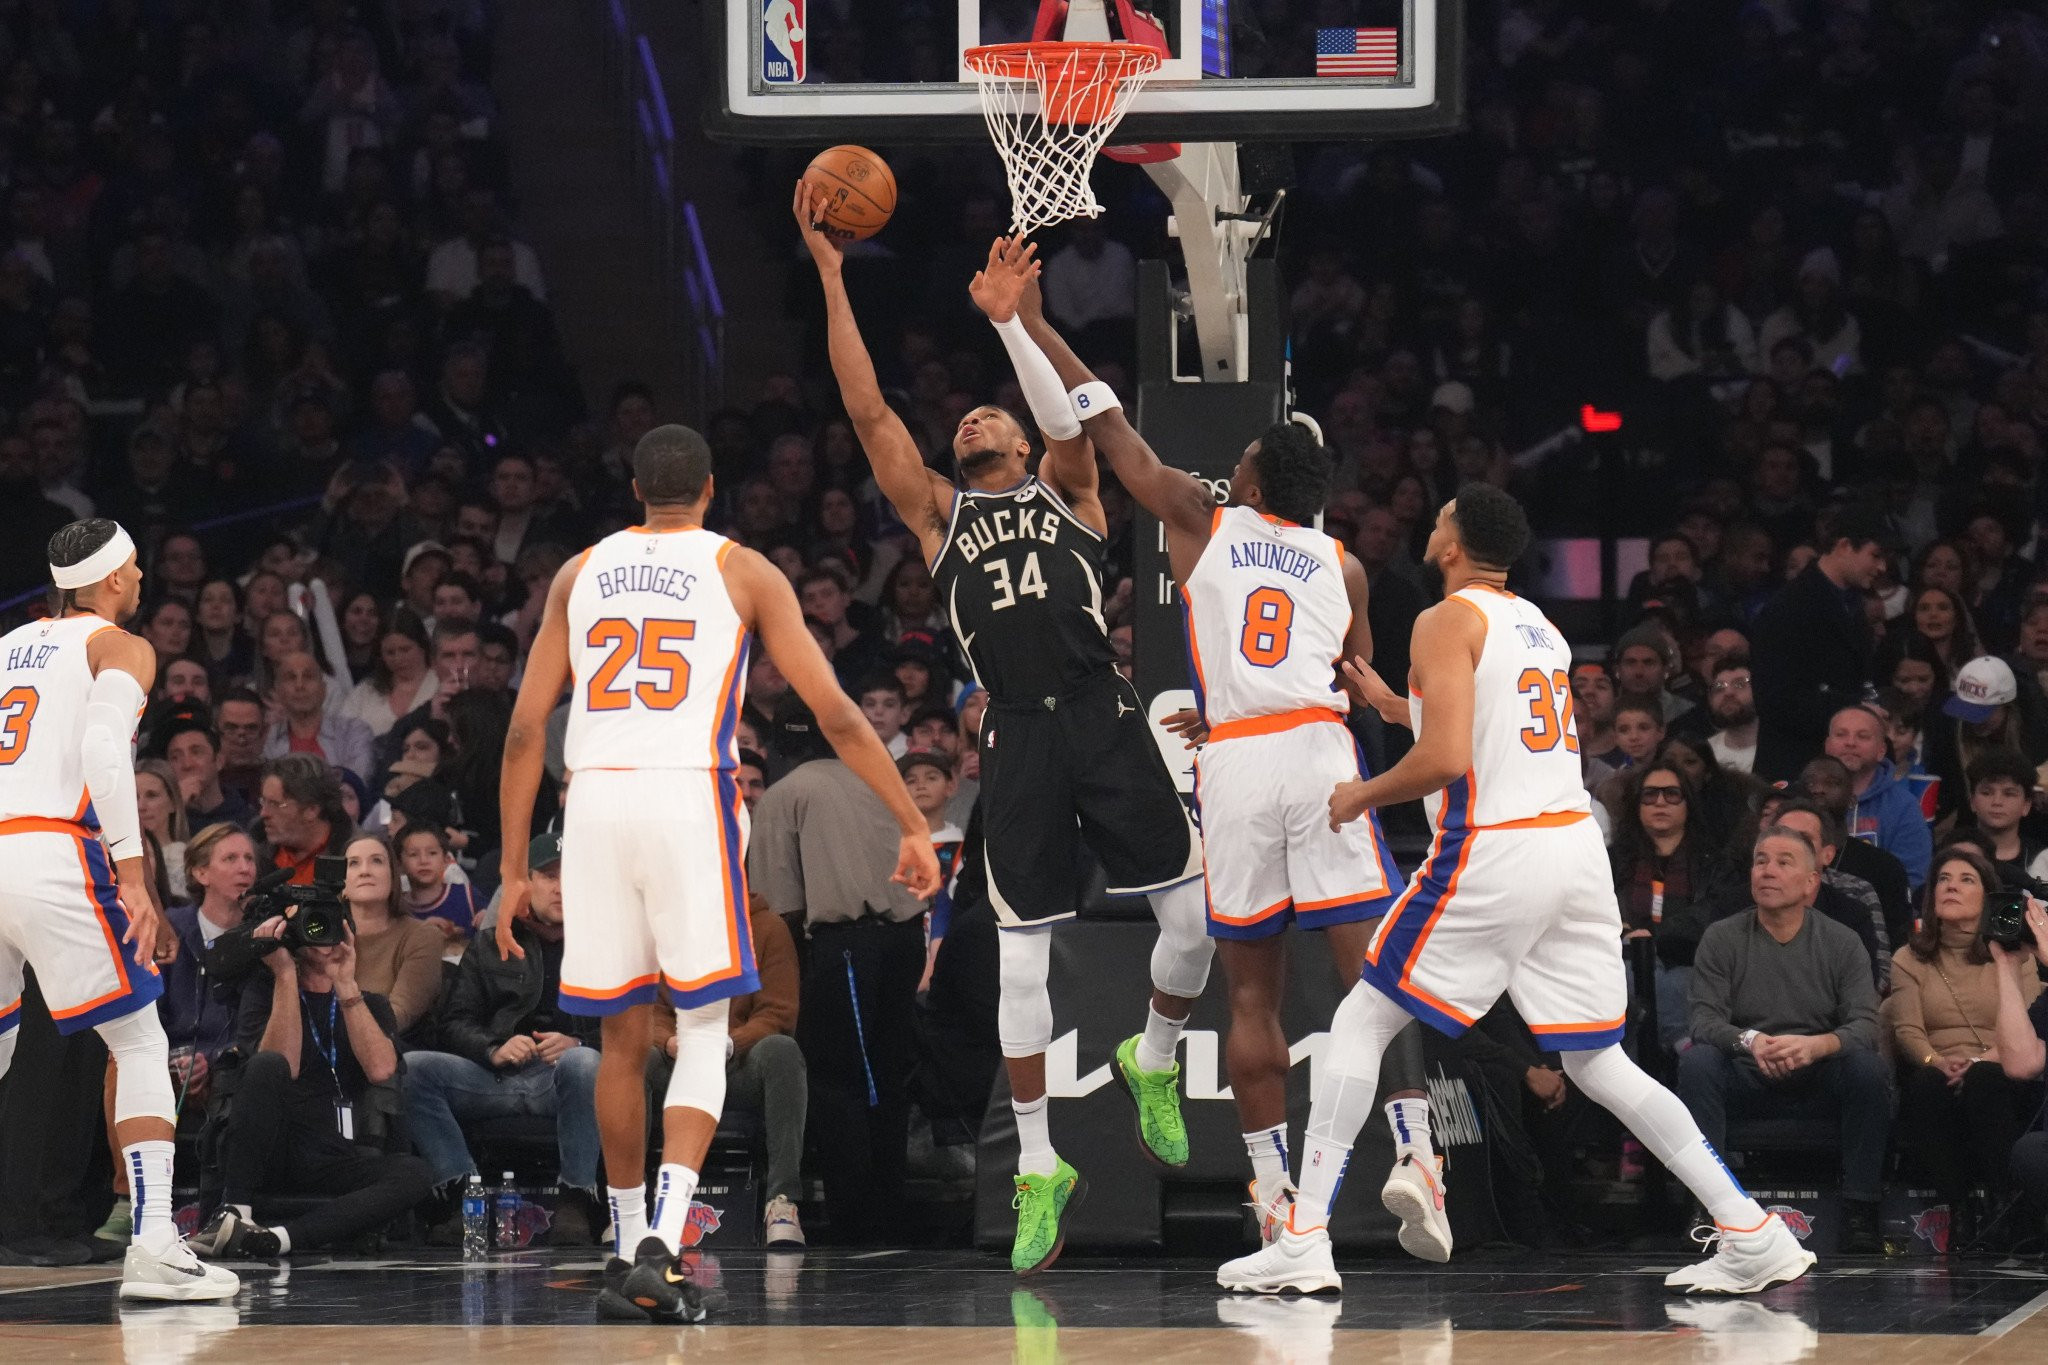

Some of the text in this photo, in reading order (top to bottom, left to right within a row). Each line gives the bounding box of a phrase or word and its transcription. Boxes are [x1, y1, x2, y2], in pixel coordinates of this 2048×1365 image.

[767, 61, 789, 78] NBA
[1077, 393, 1090, 409] 8
[955, 508, 1061, 564] BUCKS
[1230, 541, 1321, 584] ANUNOBY
[597, 564, 697, 602] BRIDGES
[983, 551, 1049, 612] 34
[1239, 585, 1295, 669] 8
[7, 644, 59, 671] HART
[586, 617, 697, 712] 25
[0, 685, 41, 766] 3
[1517, 667, 1580, 755] 32
